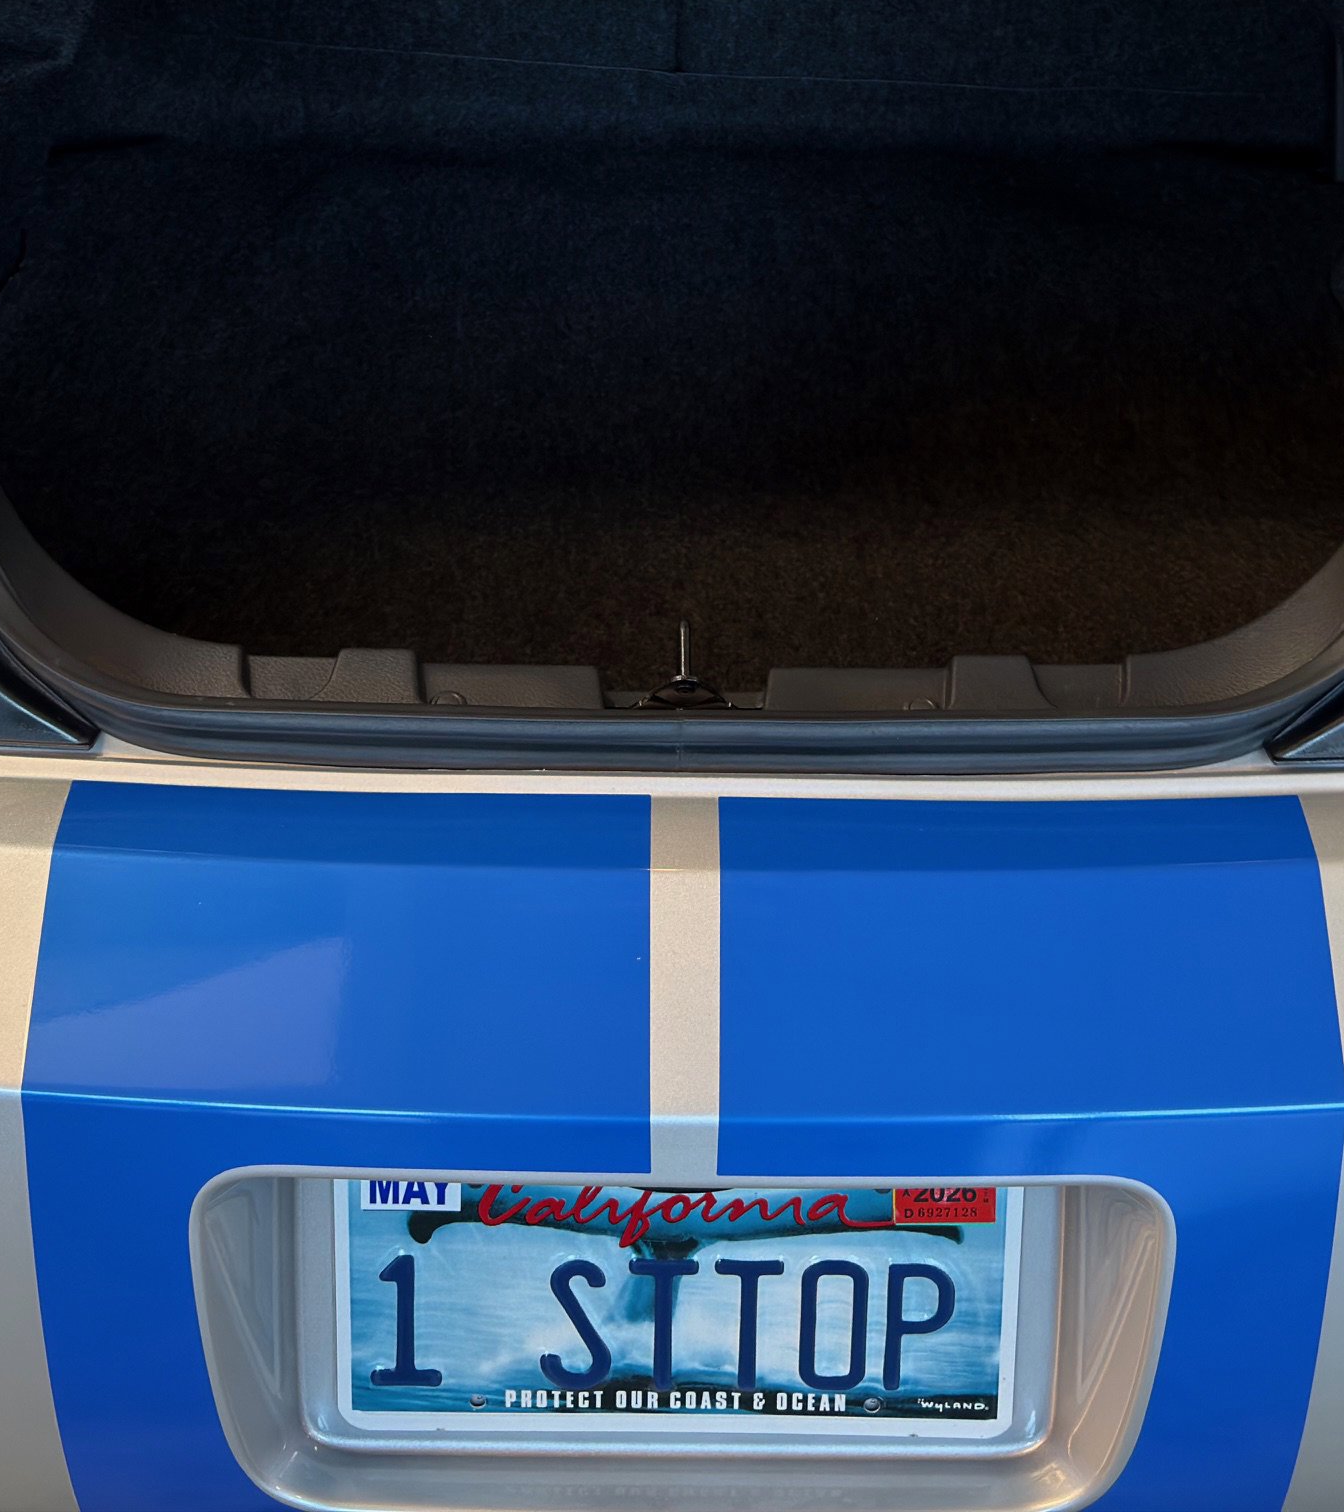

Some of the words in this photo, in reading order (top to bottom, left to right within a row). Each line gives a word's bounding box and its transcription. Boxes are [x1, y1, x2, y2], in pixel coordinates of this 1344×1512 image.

[369, 1180, 451, 1206] MAY
[913, 1188, 977, 1203] 2026
[477, 1184, 896, 1248] California
[917, 1207, 978, 1218] 6927128
[370, 1254, 443, 1387] 1
[540, 1257, 956, 1392] STTOP
[504, 1389, 604, 1409] PROTECT
[615, 1390, 659, 1410] OUR
[669, 1390, 741, 1410] COAST
[752, 1391, 766, 1410] &
[776, 1392, 847, 1412] OCEAN
